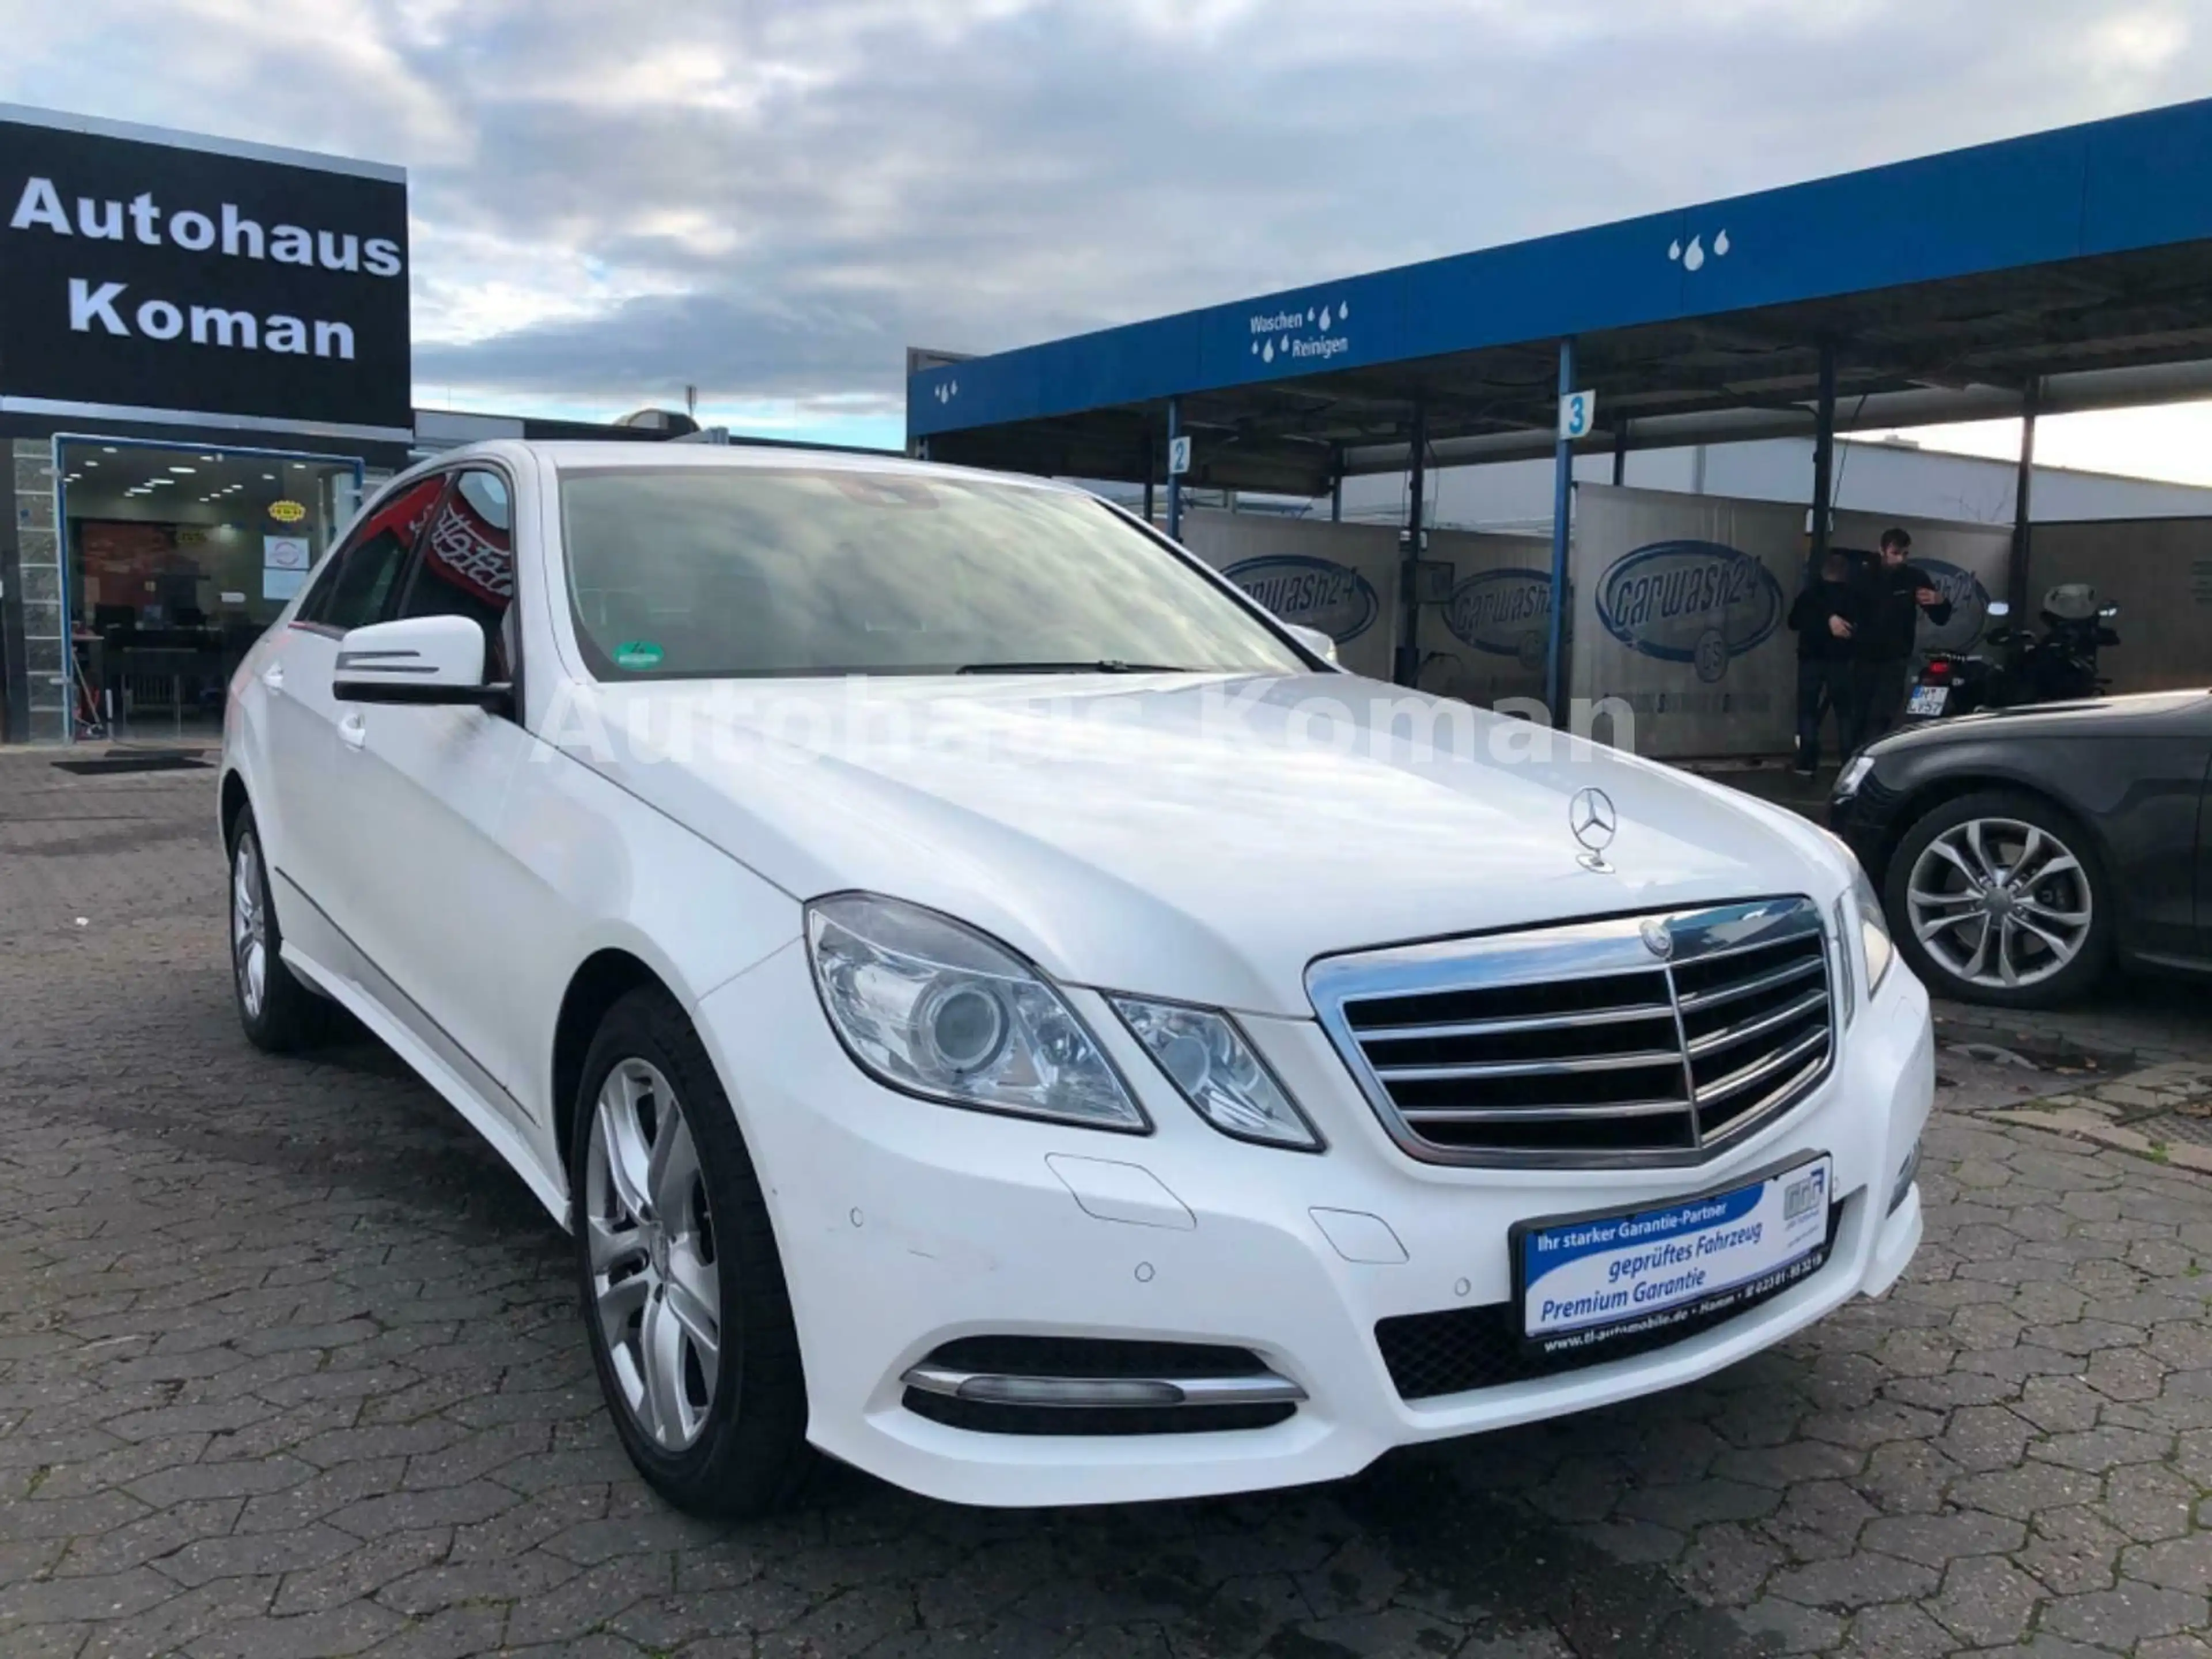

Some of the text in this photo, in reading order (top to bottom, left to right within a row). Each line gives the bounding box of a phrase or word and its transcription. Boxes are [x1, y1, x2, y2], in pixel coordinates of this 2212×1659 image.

[10, 176, 402, 277] Autohaus
[68, 277, 355, 359] Koman
[1249, 311, 1303, 334] Waschen
[1292, 335, 1349, 359] Reinigen
[1569, 396, 1584, 434] 3
[1175, 441, 1185, 471] 2
[1613, 555, 1762, 628] carwash24
[1537, 1203, 1728, 1252] Ihr starker Garantie-Partner
[1608, 1242, 1693, 1283] geprüftes
[1696, 1222, 1763, 1258] Fahrzeug
[1541, 1267, 1706, 1322] Premium Garantie
